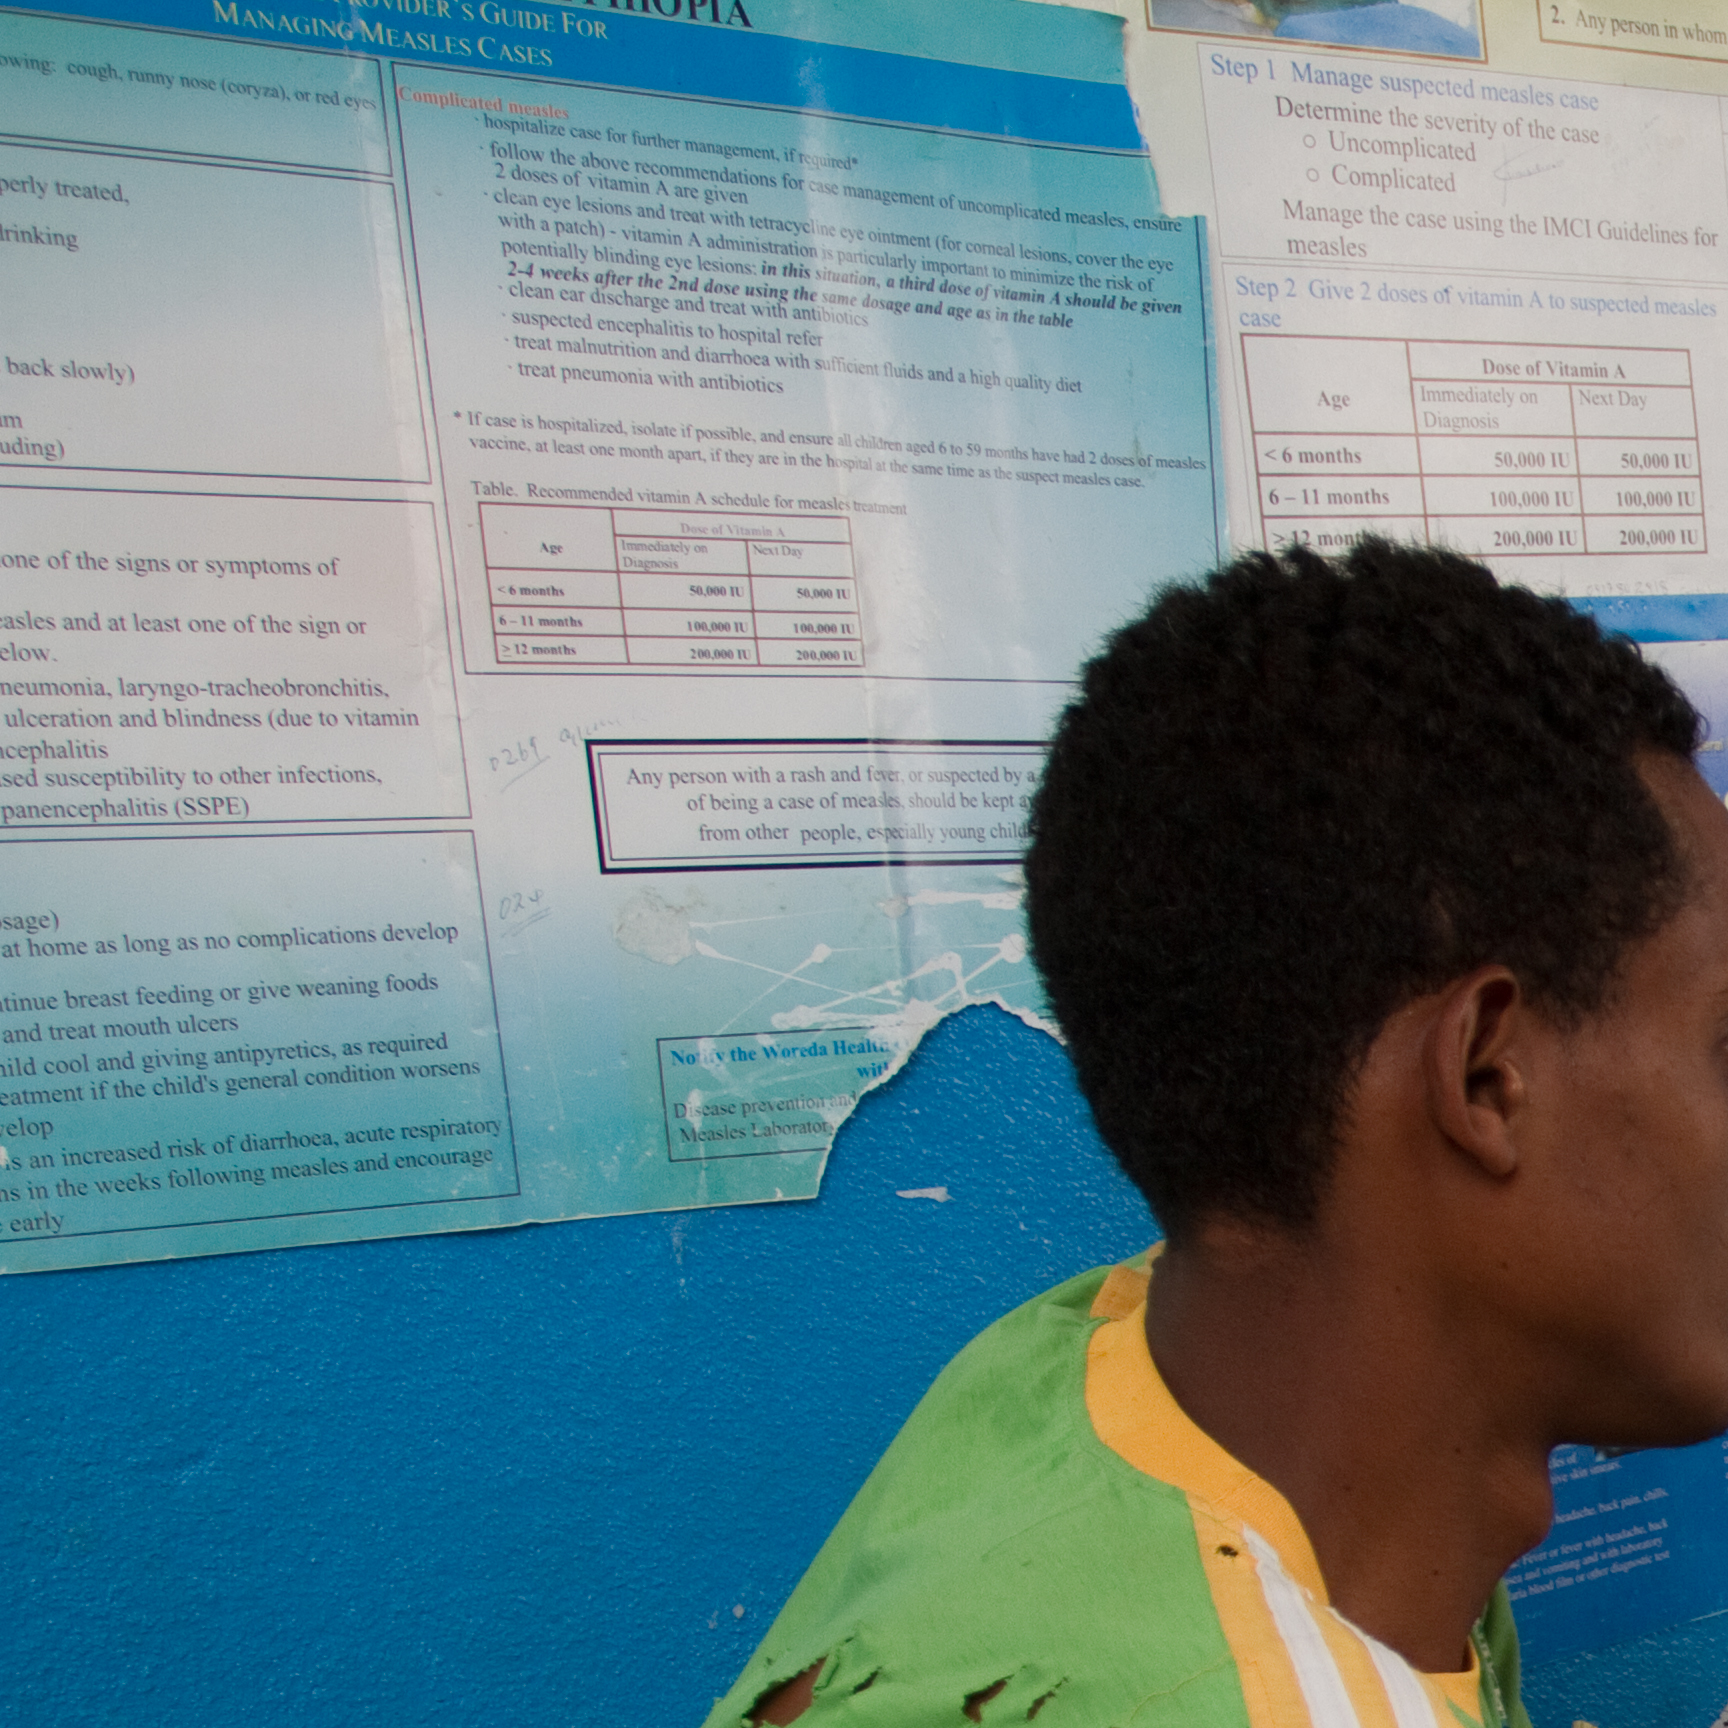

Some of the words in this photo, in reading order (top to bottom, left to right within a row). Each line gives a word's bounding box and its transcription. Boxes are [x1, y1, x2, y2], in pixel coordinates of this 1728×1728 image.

[213, 0, 355, 42] MANAGING
[360, 20, 472, 57] MEASLES
[477, 36, 553, 67] CASES
[478, 0, 556, 33] GUIDE
[561, 10, 608, 40] FOR
[1550, 6, 1566, 25] 2.
[1575, 9, 1607, 36] Any
[1609, 16, 1661, 38] person
[1663, 24, 1679, 40] in
[1681, 22, 1728, 46] whom
[65, 62, 124, 83] cough,
[126, 69, 176, 90] runny
[178, 75, 217, 92] nose
[218, 77, 291, 102] (coryza),
[292, 89, 312, 103] or
[314, 89, 341, 107] red
[343, 92, 378, 111] eyes
[1210, 55, 1259, 85] Step
[1268, 60, 1276, 81] 1
[1291, 62, 1374, 95] Manage
[1379, 75, 1476, 100] suspected
[1480, 83, 1555, 107] measles
[1559, 93, 1599, 112] case
[398, 86, 503, 113] Complicated
[507, 99, 570, 119] measles
[1329, 131, 1477, 163] Uncomplicated
[1331, 165, 1457, 194] Complicated
[1282, 198, 1364, 230] Manage
[1368, 203, 1400, 227] the
[1404, 212, 1448, 230] case
[1452, 215, 1505, 239] using
[1509, 212, 1538, 236] the
[1542, 215, 1592, 239] IMCI
[1596, 219, 1689, 246] Guidelines
[1693, 225, 1719, 248] for
[1286, 236, 1368, 258] measles
[1234, 275, 1280, 304] Step
[1284, 277, 1298, 298] 2
[1307, 278, 1355, 301] Give
[1359, 280, 1372, 302] 2
[1376, 281, 1429, 304] doses
[1432, 284, 1454, 305] of
[1456, 290, 1524, 308] vitamin
[1528, 289, 1545, 309] A
[1548, 293, 1566, 310] to
[1569, 294, 1651, 318] suspected
[1653, 297, 1718, 318] measles
[1239, 312, 1282, 328] case
[5, 357, 56, 378] back
[60, 359, 136, 386] slowly)
[1482, 358, 1521, 376] Dose
[1525, 359, 1543, 377] of
[1545, 360, 1609, 379] Vitamin
[1613, 363, 1627, 380] A
[0, 553, 40, 570] one
[46, 549, 72, 570] of
[75, 550, 109, 572] the
[115, 553, 171, 578] signs
[175, 558, 200, 574] or
[204, 558, 312, 580] symptoms
[316, 556, 341, 577] of
[118, 678, 390, 702] laryngo-tracheobronchitis,
[3, 707, 113, 728] ulceration
[118, 708, 159, 728] and
[161, 707, 263, 728] blindness
[267, 707, 313, 731] (due
[318, 711, 339, 727] to
[343, 711, 420, 727] vitamin
[44, 766, 186, 792] susceptibility
[192, 769, 214, 786] to
[218, 765, 272, 785] other
[277, 765, 383, 785] infections,
[626, 767, 663, 790] Any
[667, 771, 728, 790] person
[731, 767, 771, 784] with
[775, 770, 787, 784] a
[789, 767, 826, 783] rash
[830, 767, 862, 783] and
[927, 766, 1000, 788] suspected
[1002, 766, 1023, 788] by
[173, 796, 250, 819] (SSPE)
[1, 941, 22, 959] at
[25, 937, 89, 958] home
[95, 940, 118, 955] as
[122, 933, 172, 957] long
[176, 936, 200, 952] as
[203, 935, 231, 950] no
[235, 927, 378, 952] complications
[381, 921, 459, 945] develop
